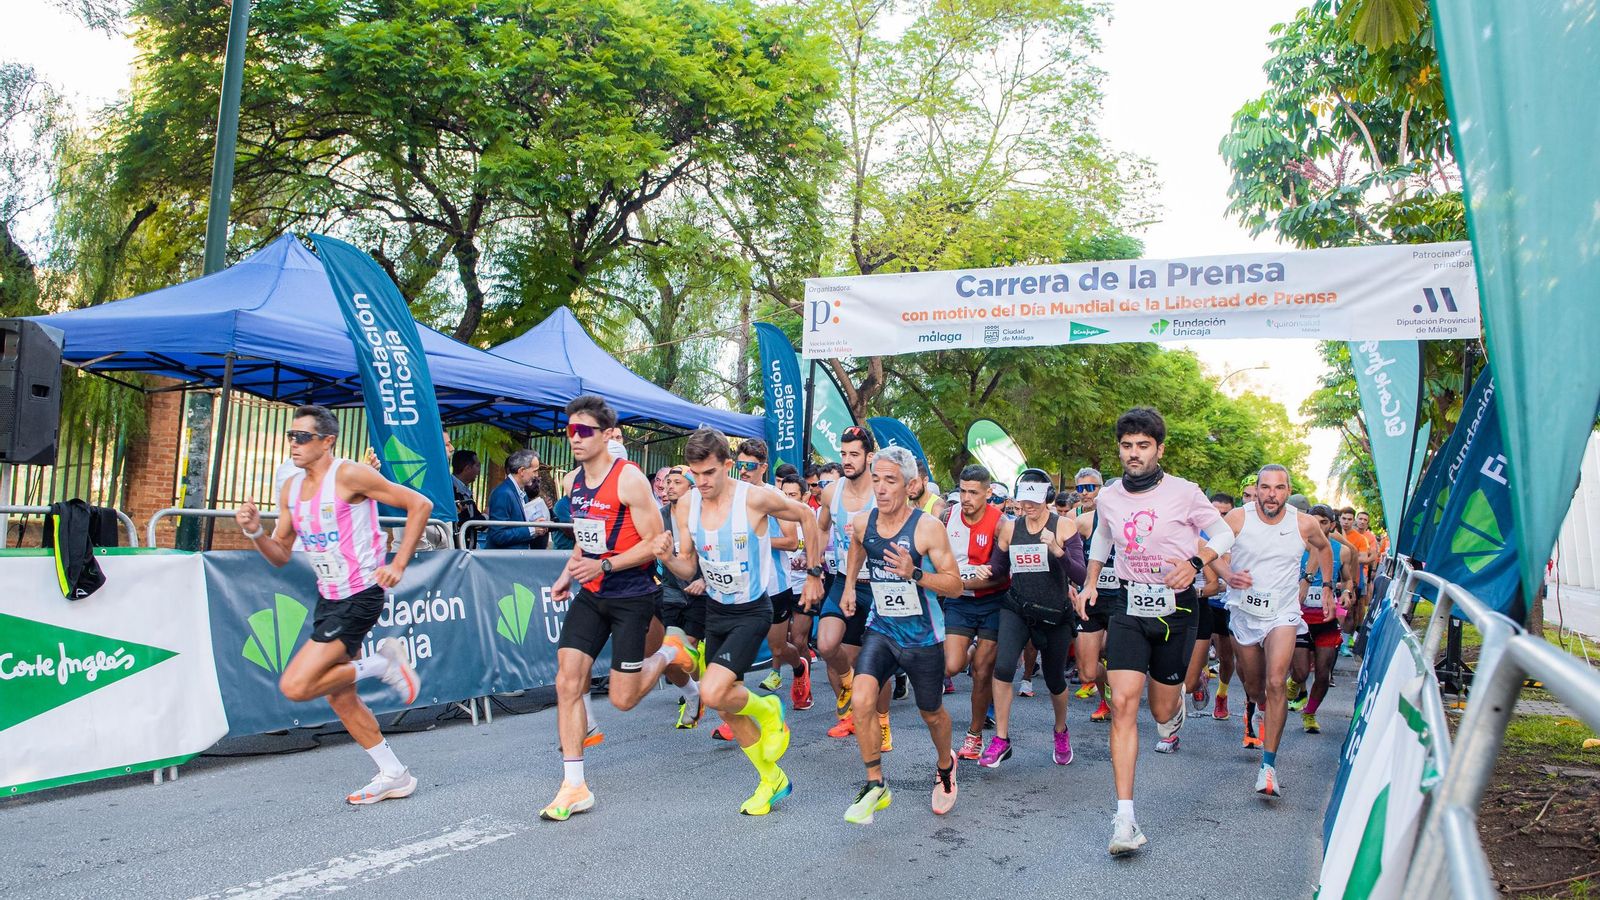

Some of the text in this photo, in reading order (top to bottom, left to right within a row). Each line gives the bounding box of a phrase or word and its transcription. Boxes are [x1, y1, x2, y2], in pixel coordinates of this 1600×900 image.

[956, 261, 1285, 298] Carrera de la Prensa
[902, 291, 1337, 322] con motivo del Día Mundial de la Libertad de Prensa
[1173, 318, 1226, 328] Fundación
[1396, 317, 1476, 327] Diputación Provincial
[918, 330, 962, 344] málaga
[1173, 328, 1211, 337] Unicaja
[1428, 326, 1457, 334] Málaga
[353, 293, 399, 426] Fundación
[385, 330, 420, 426] Unicaja
[770, 359, 786, 451] Fundación
[783, 384, 797, 449] Unicaja
[1016, 554, 1041, 564] 558
[707, 570, 733, 585] 330
[885, 595, 905, 606] 24
[1134, 595, 1166, 607] 324
[1246, 595, 1270, 608] 981
[374, 590, 466, 627] dación
[0, 653, 55, 680] Corte
